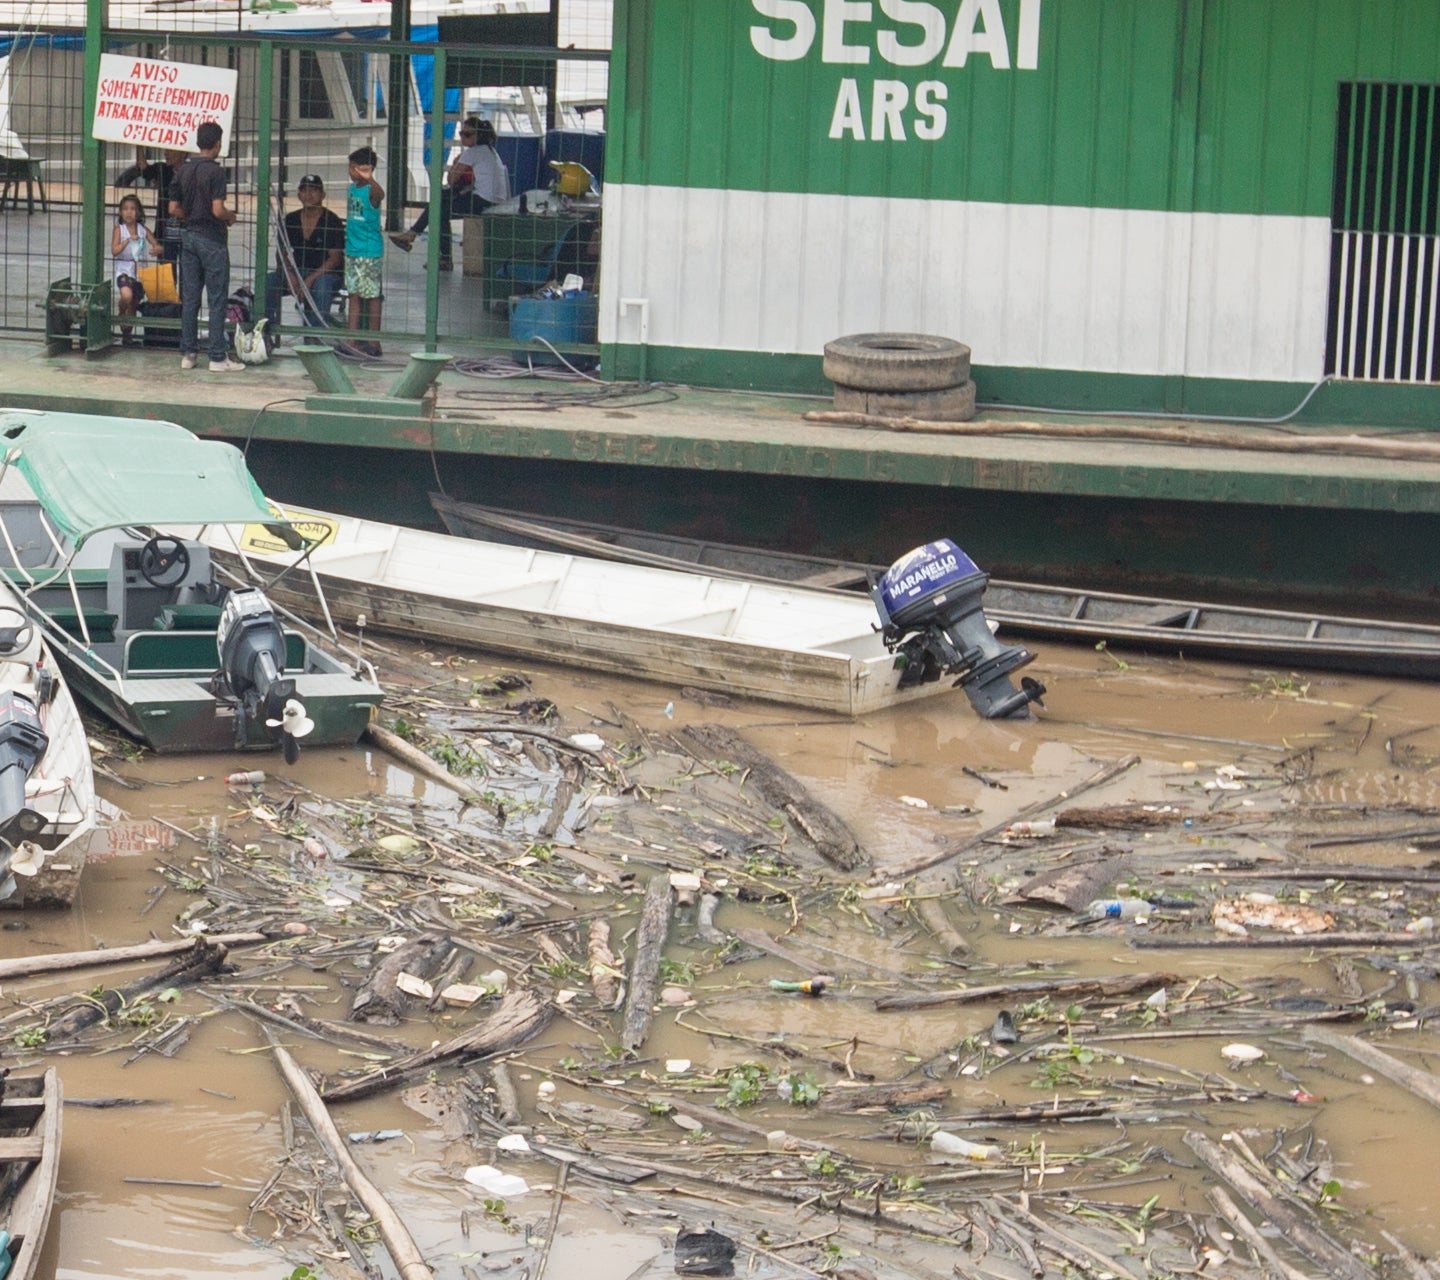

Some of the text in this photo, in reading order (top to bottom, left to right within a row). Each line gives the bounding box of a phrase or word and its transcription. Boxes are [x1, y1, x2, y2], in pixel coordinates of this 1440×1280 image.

[130, 62, 179, 84] AVISO
[100, 78, 156, 103] SOMENTE
[163, 87, 230, 112] PERMITIDO
[97, 101, 146, 122] ATRACAR
[828, 78, 948, 141] ARS
[123, 124, 188, 146] OFICIAIS
[889, 555, 957, 599] MARANELLO
